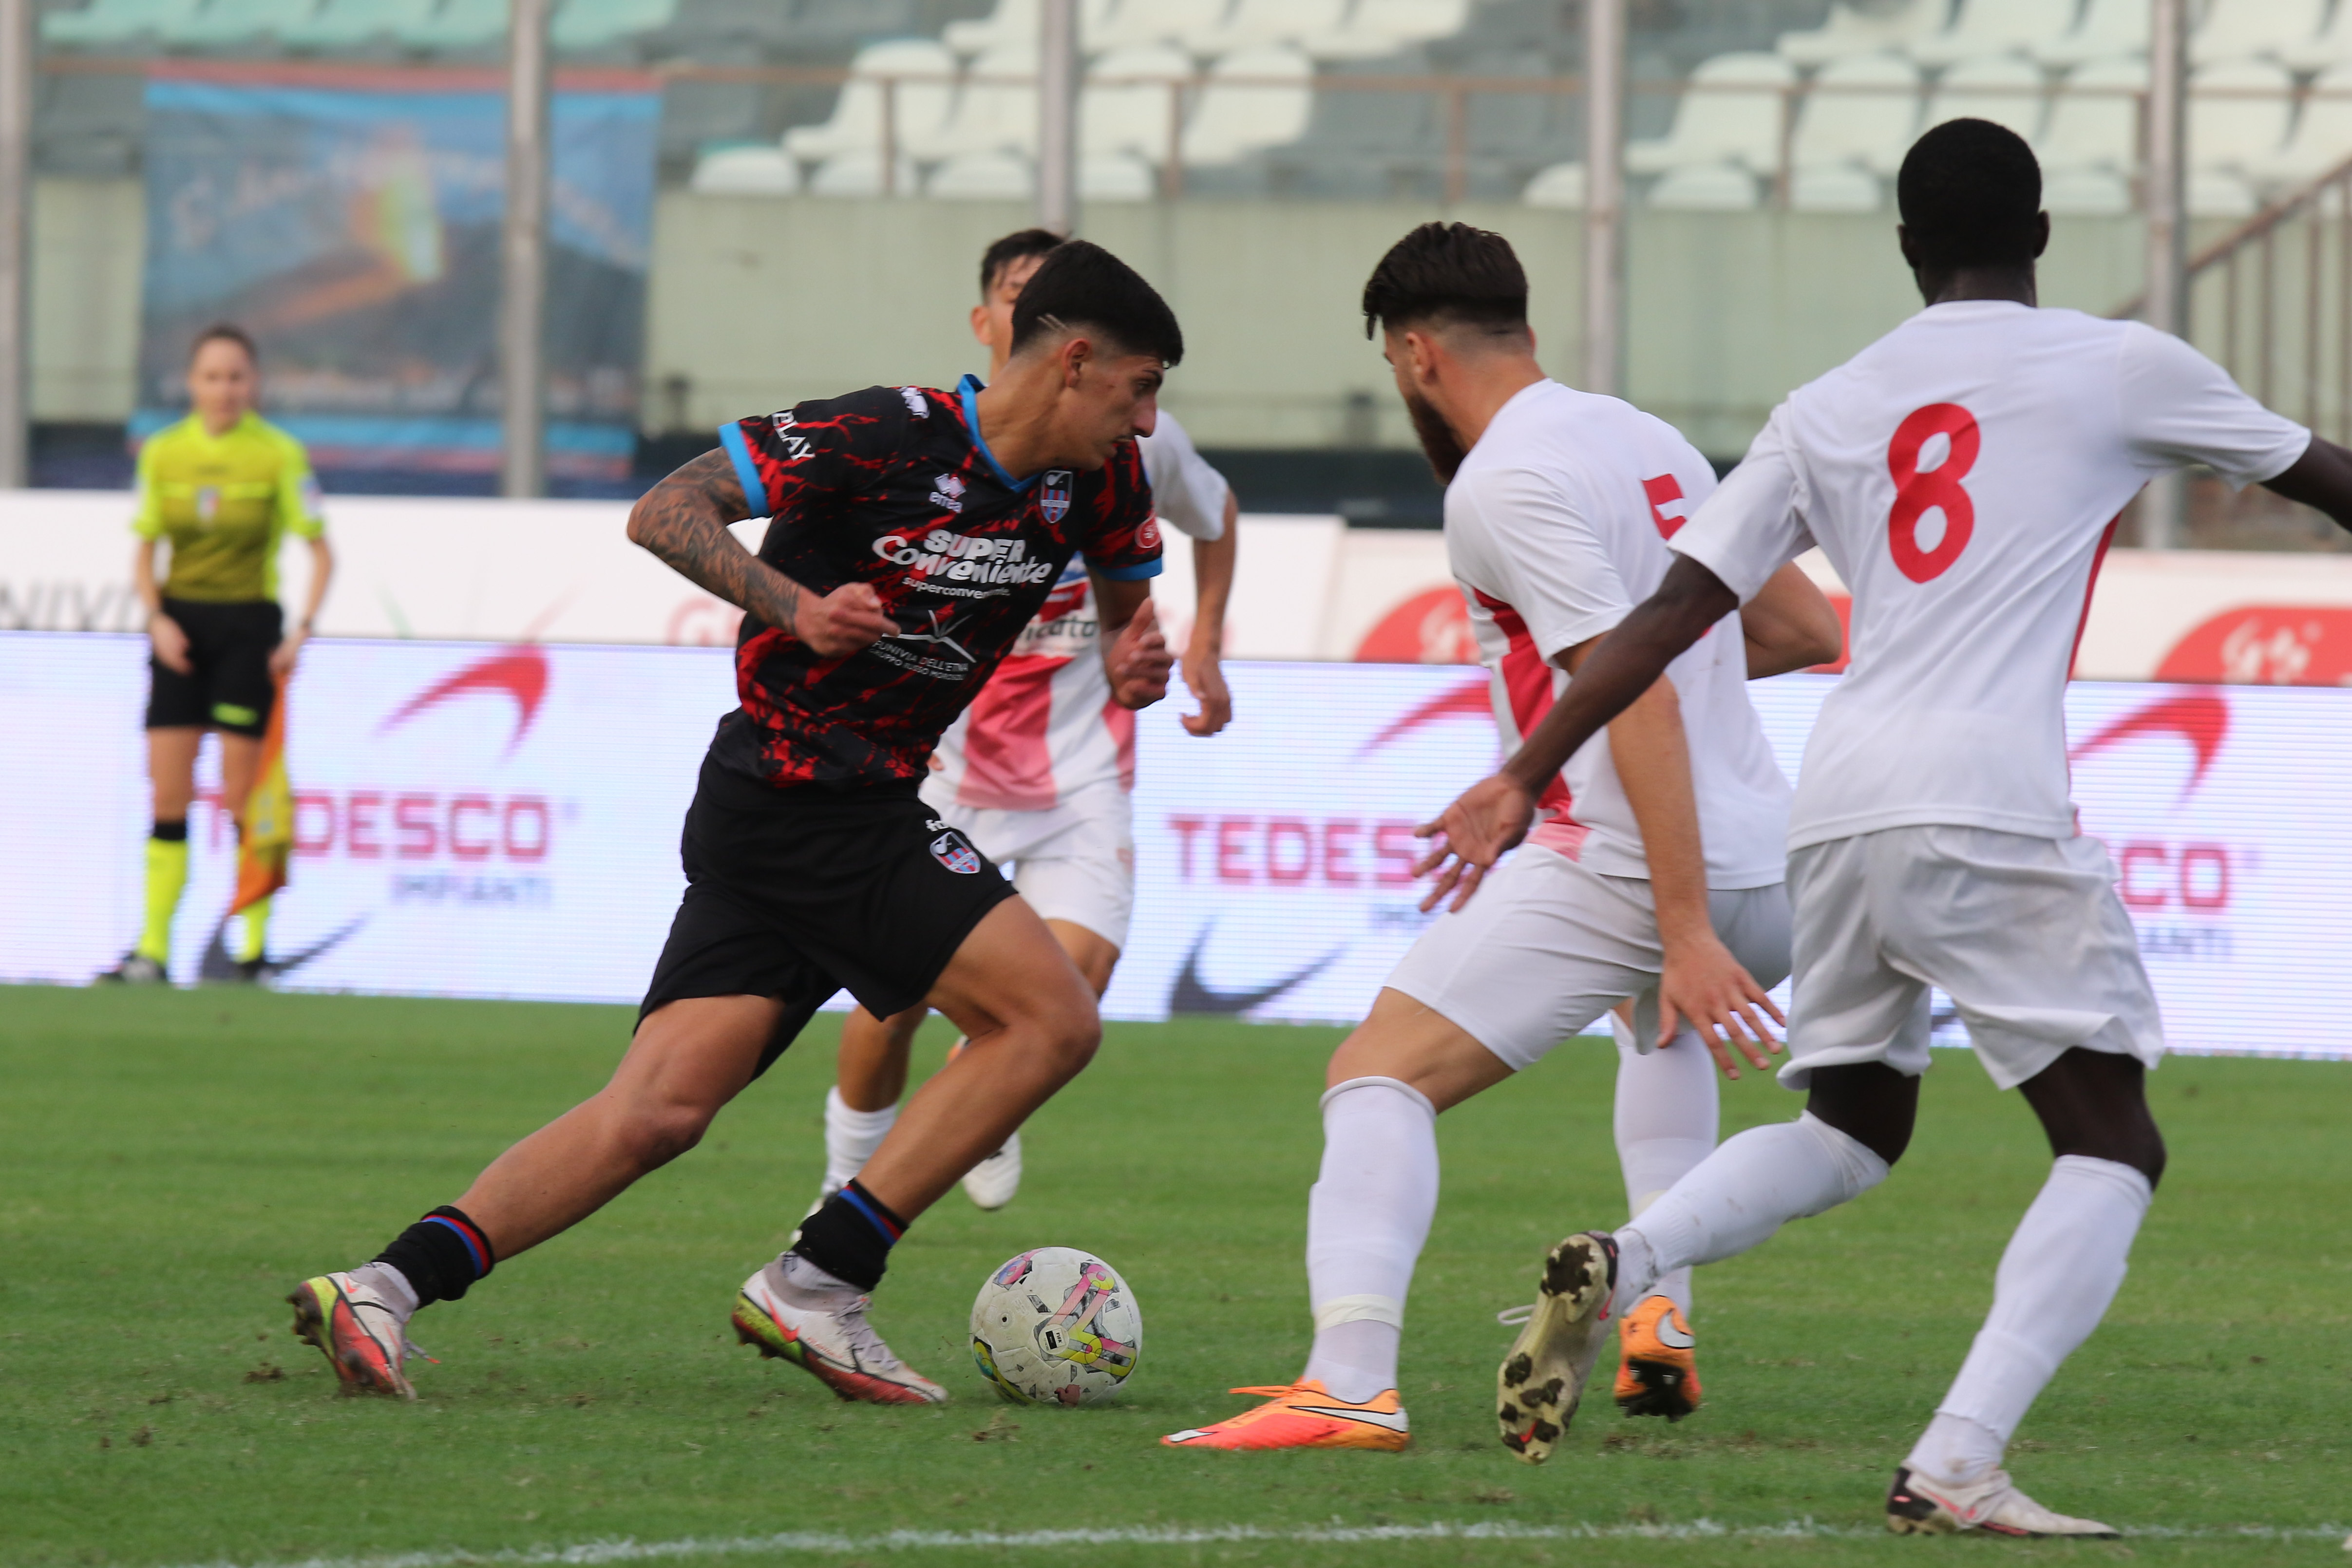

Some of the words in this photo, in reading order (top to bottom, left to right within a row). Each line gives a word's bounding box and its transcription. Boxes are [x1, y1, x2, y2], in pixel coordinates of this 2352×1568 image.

[1888, 402, 1981, 584] 8
[872, 535, 1053, 584] Conveniente
[924, 529, 1025, 562] SUPER
[195, 789, 549, 860] TDESCO
[1168, 812, 1454, 889] TEDES
